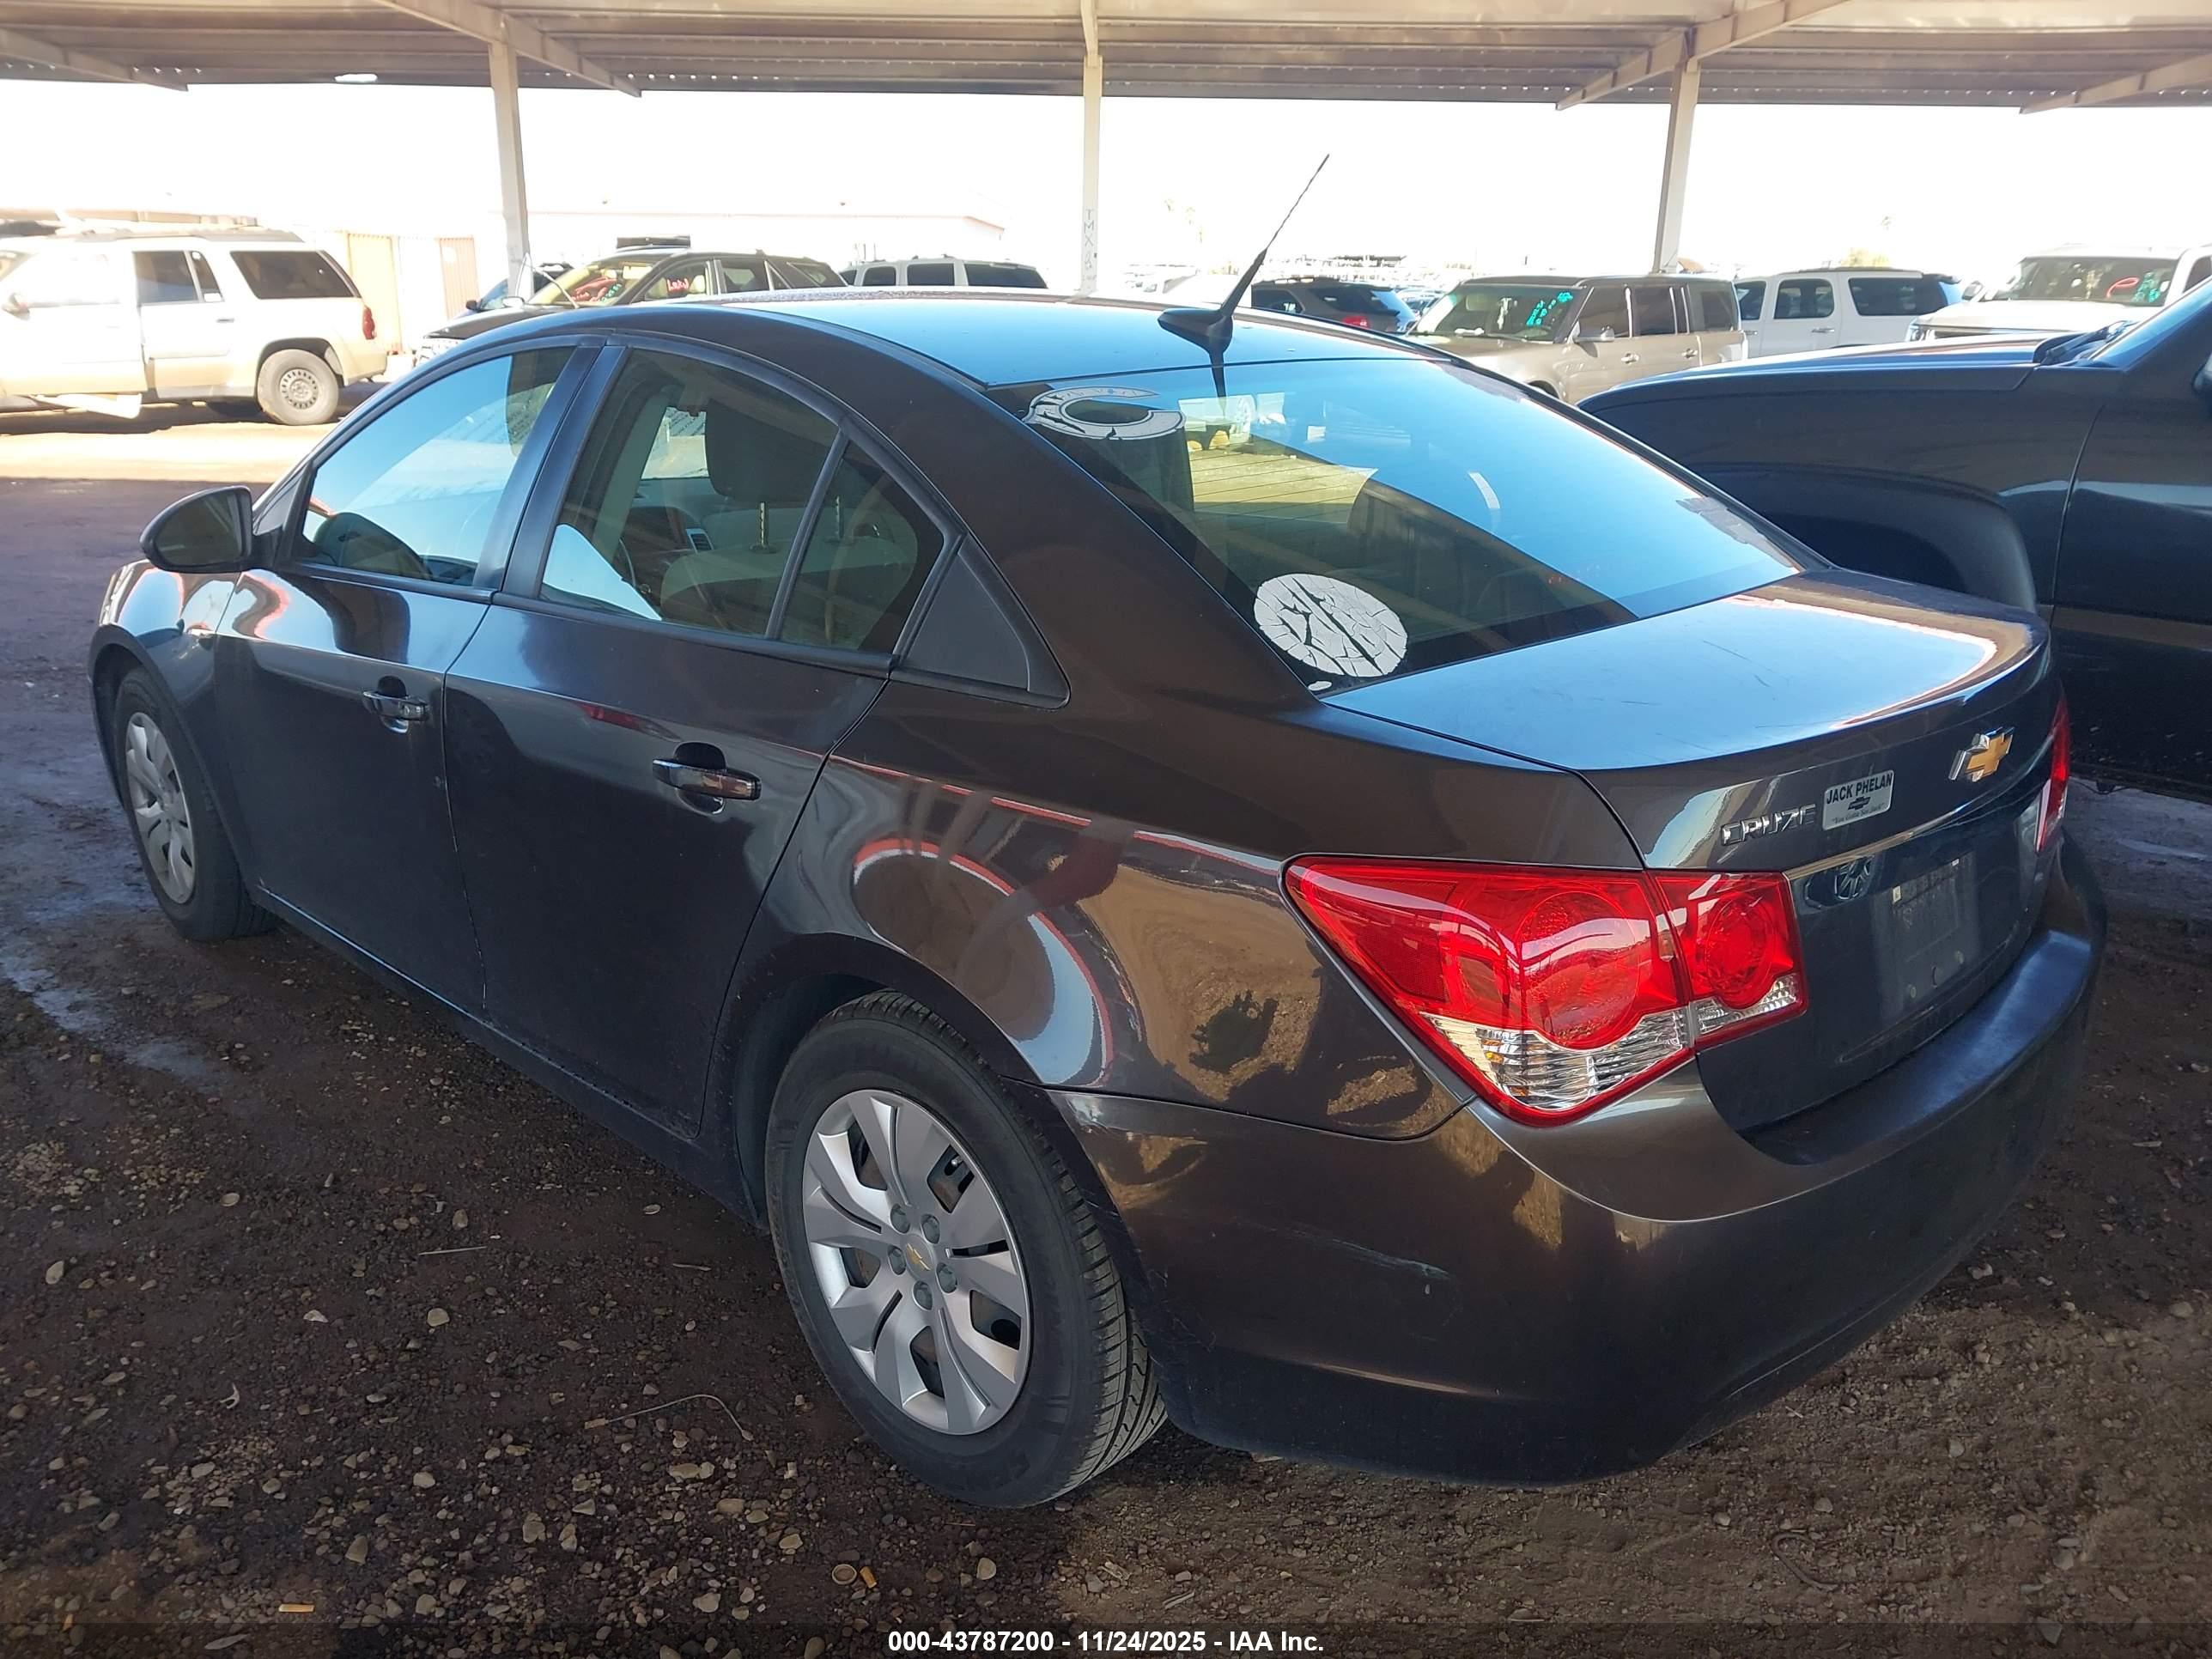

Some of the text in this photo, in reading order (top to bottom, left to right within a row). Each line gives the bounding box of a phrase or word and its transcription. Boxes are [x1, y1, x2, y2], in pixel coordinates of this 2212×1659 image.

[1826, 773, 1893, 804] JACK PHELAN
[1720, 804, 1816, 846] CRUZE
